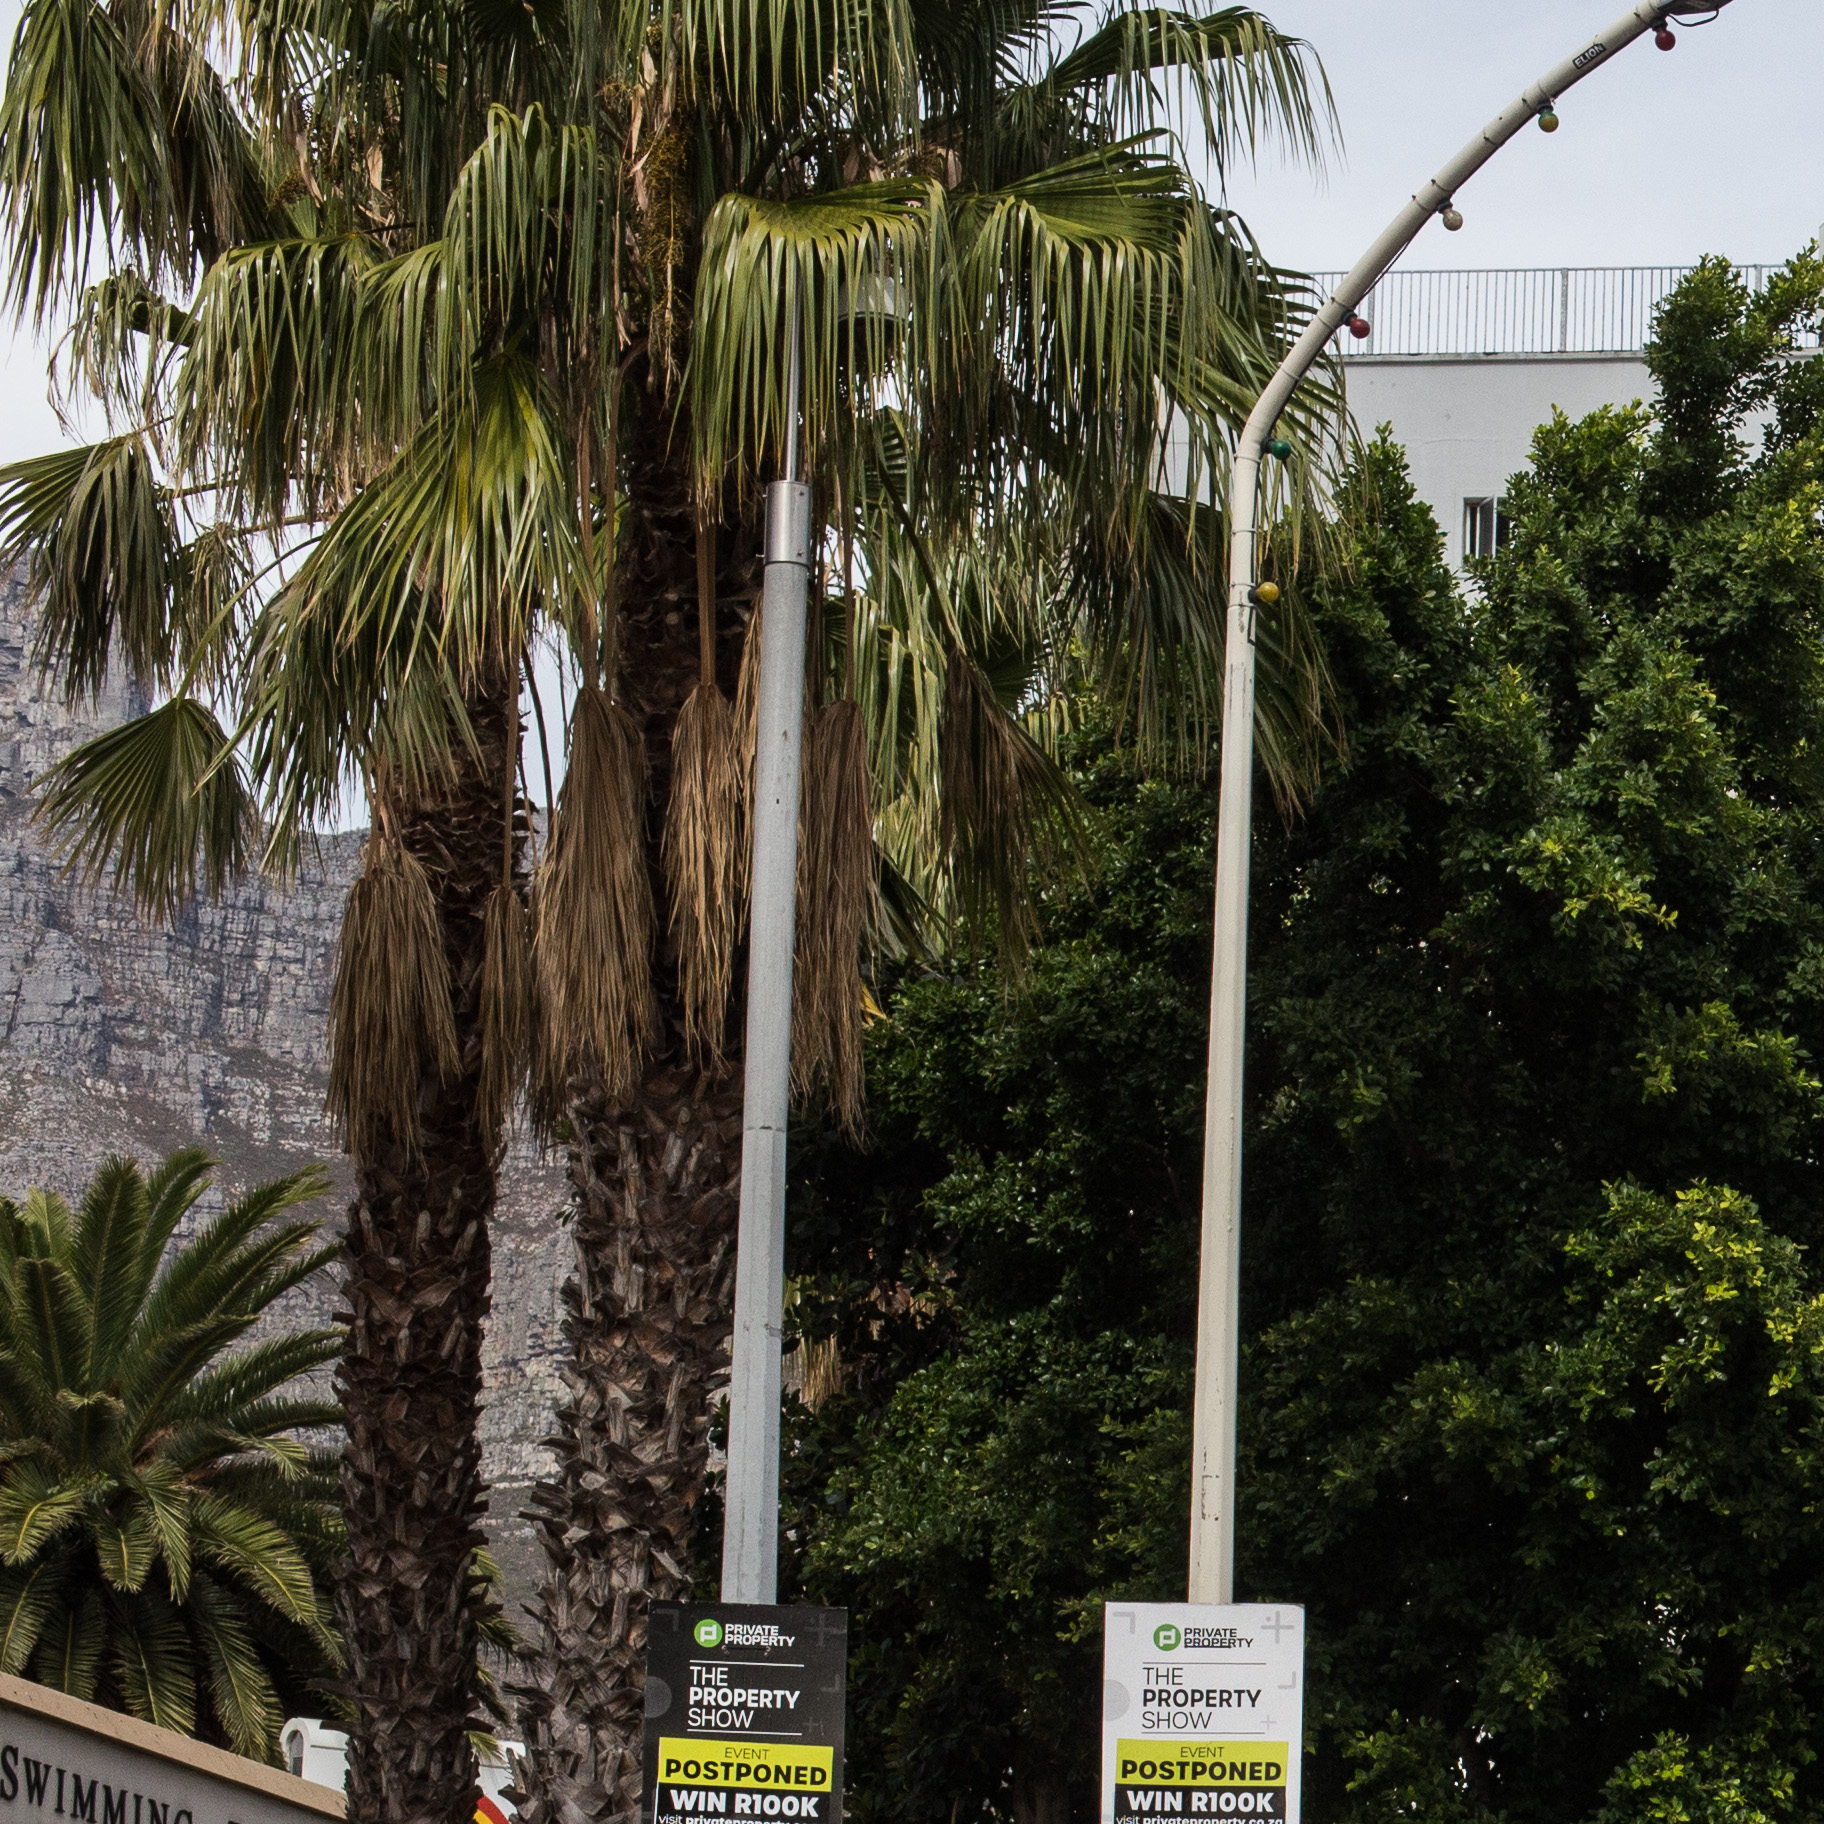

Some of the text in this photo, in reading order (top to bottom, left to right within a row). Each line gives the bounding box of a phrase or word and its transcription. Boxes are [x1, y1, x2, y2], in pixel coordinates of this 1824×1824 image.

[725, 1624, 779, 1636] PRIVATE
[1184, 1628, 1237, 1637] PRIVATE
[725, 1634, 795, 1646] PROPERTY
[1184, 1638, 1253, 1648] PROPERTY
[690, 1666, 728, 1686] THE
[1142, 1667, 1184, 1685] THE
[689, 1687, 800, 1709] PROPERTY
[1143, 1689, 1262, 1708] PROPERTY
[687, 1708, 754, 1728] SHOW
[1142, 1711, 1212, 1729] SHOW
[725, 1747, 770, 1760] EVENT
[1180, 1747, 1224, 1758] EVENT
[665, 1759, 827, 1785] POSTPONED
[1121, 1760, 1281, 1781] POSTPONED
[670, 1790, 819, 1818] WIN R100K
[1127, 1790, 1274, 1813] WIN R100K
[659, 1814, 682, 1824] visit
